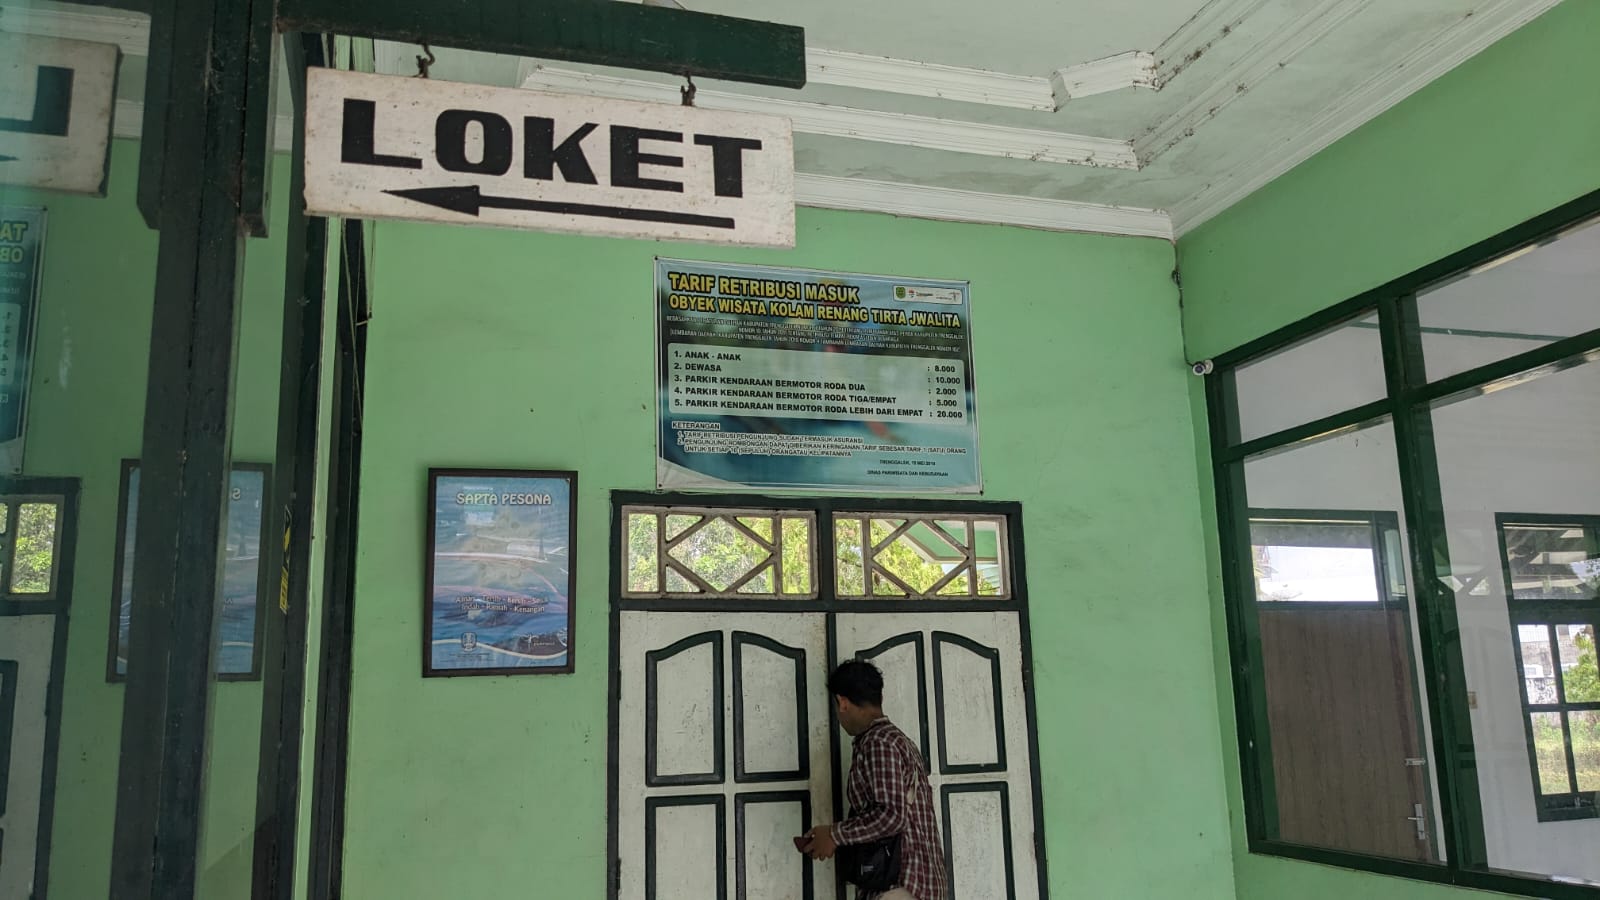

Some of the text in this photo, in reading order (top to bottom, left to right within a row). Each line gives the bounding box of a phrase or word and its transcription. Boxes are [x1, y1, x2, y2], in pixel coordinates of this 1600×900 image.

[341, 98, 762, 199] LOKET
[668, 272, 859, 303] TARIF RETRIBUSI MASUK
[669, 294, 961, 328] OBYEK WISATA KOLAM RENANG TIRTA JWALITA
[674, 350, 682, 358] 1.
[685, 351, 709, 360] ANAK
[717, 352, 742, 361] ANAK
[934, 365, 955, 373] 8.000
[685, 363, 722, 372] DEWASA
[935, 376, 961, 384] 10.000
[685, 375, 718, 384] PARKIR
[720, 376, 773, 387] KENDARAAN
[775, 379, 822, 389] BERMOTOR
[824, 382, 847, 390] RODA
[849, 383, 866, 391] DUA
[936, 388, 957, 396] 2.000
[674, 387, 682, 395] 4.
[685, 387, 718, 396] PARKIR
[720, 388, 773, 399] KENDARAAN
[775, 391, 822, 401] BERMOTOR
[824, 394, 847, 402] RODA
[849, 395, 897, 404] TIGA/EMPAT
[936, 399, 958, 407] 5.000
[674, 399, 683, 407] 5.
[685, 399, 718, 408] PARKIR
[720, 400, 774, 411] KENDARAAN
[776, 403, 823, 413] BERMOTOR
[825, 405, 848, 414] RODA
[850, 407, 874, 415] LEBIH
[876, 408, 895, 416] DARI
[897, 409, 924, 417] EMPAT
[937, 410, 963, 419] 20.000
[672, 421, 720, 430] KETERANGAN
[456, 493, 552, 505] SAPTA PESONA
